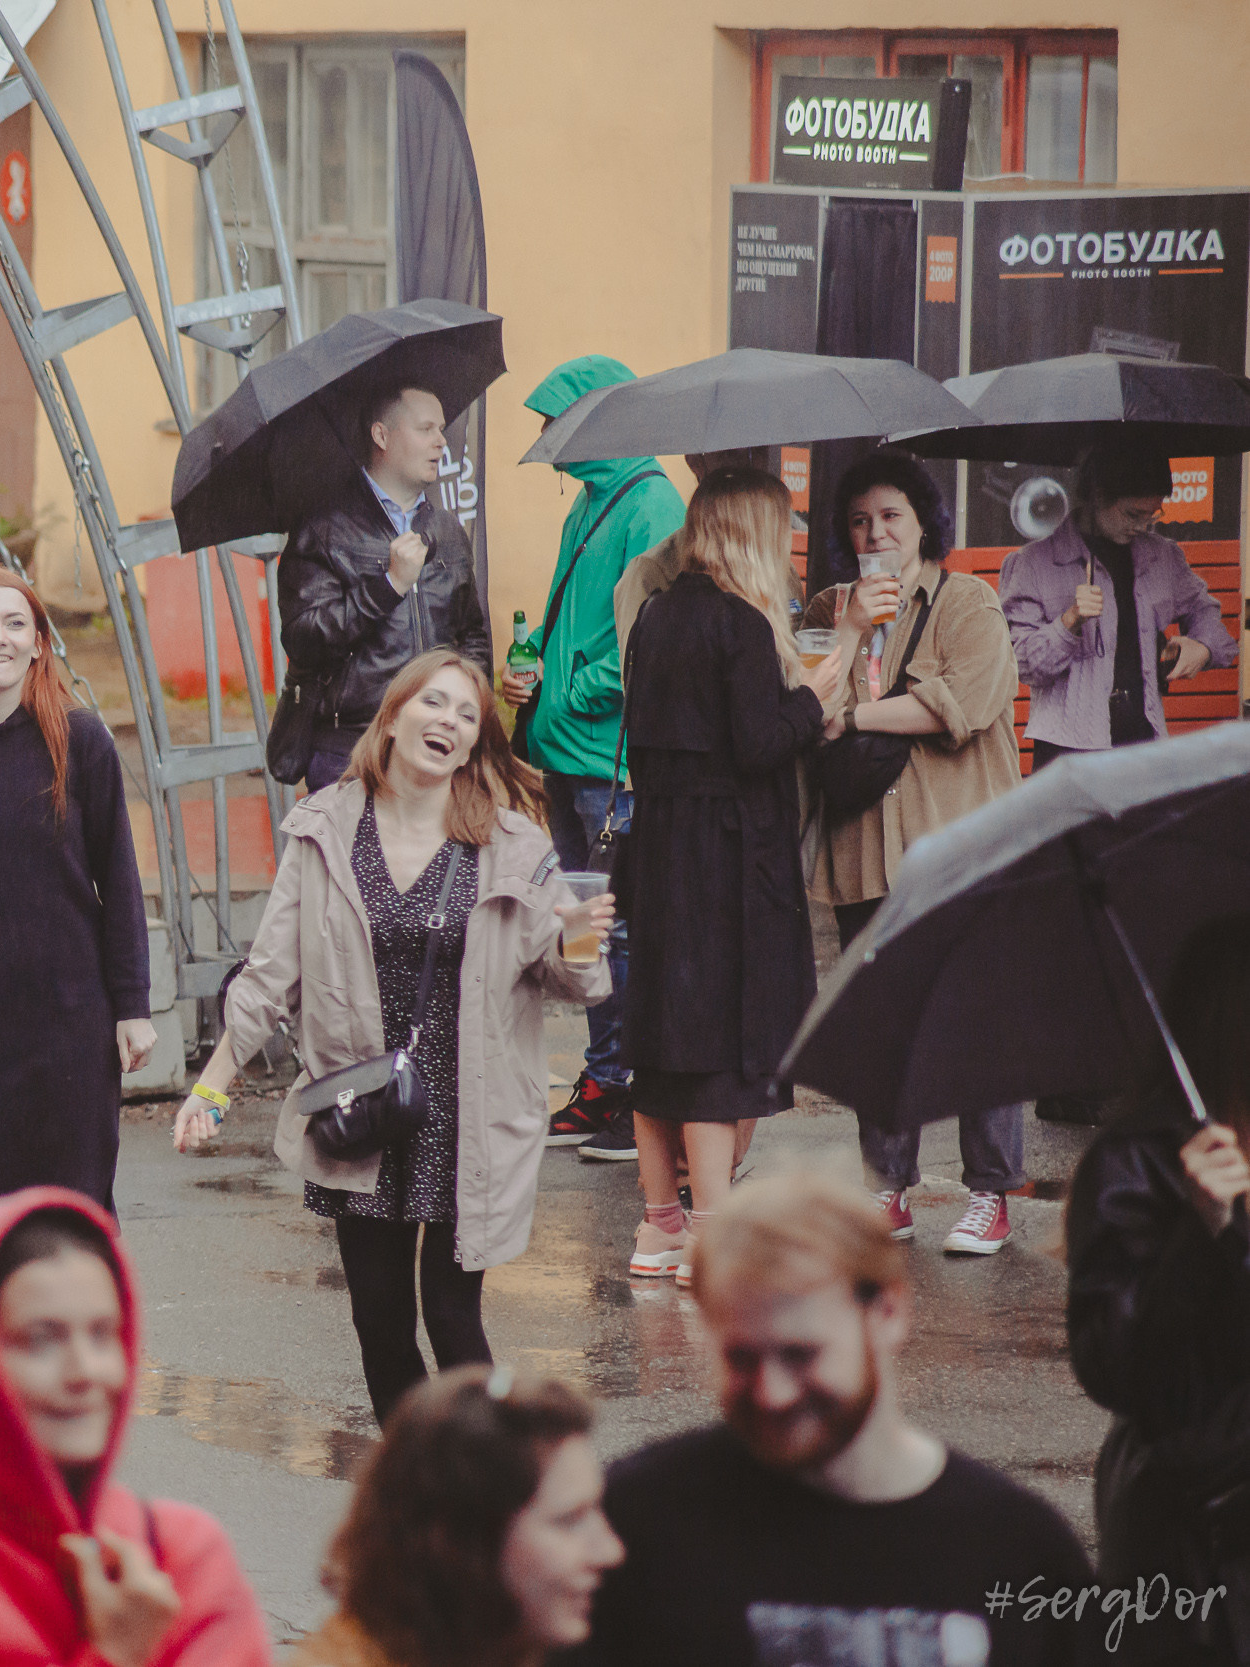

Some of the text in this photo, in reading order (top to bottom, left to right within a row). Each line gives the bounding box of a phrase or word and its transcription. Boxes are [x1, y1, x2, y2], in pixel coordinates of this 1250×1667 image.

[785, 97, 932, 143] ФОТОБУДКА
[813, 143, 898, 165] PHOTO BOOTH
[999, 229, 1224, 265] ФОТОБУДКА
[1071, 268, 1151, 279] PHOTO BOOTH
